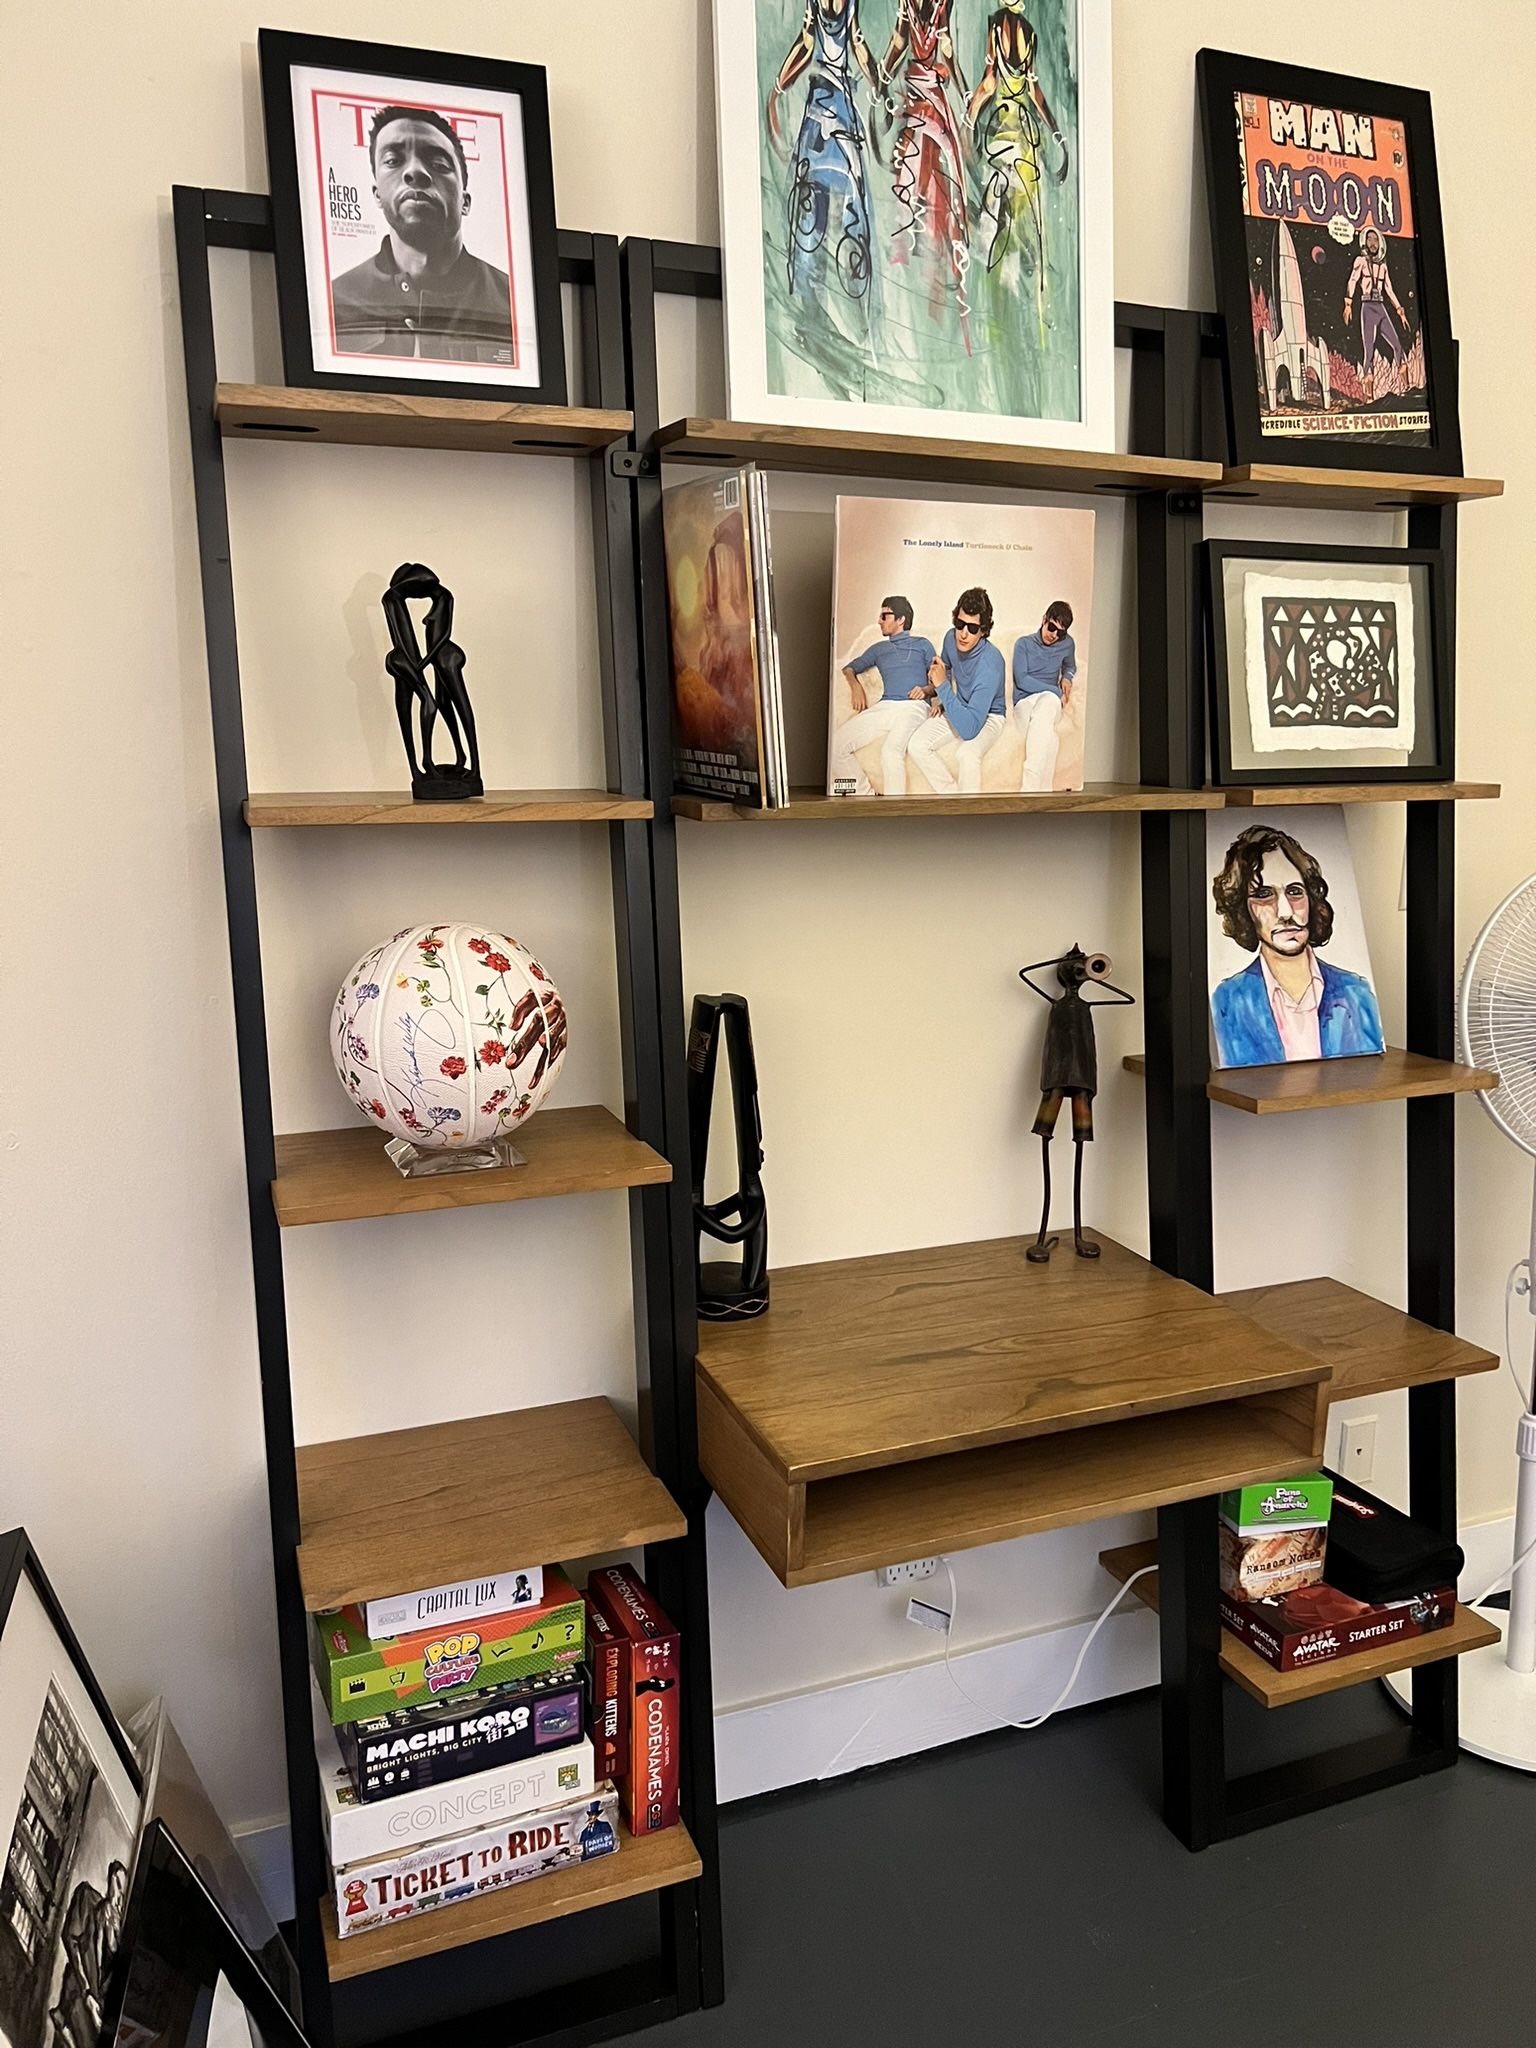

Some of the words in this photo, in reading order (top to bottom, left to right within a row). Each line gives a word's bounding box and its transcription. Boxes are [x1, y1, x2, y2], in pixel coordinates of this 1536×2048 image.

[339, 102, 480, 161] TE
[1267, 98, 1376, 159] MAN
[328, 166, 336, 184] A
[1306, 154, 1325, 165] ON
[1328, 156, 1349, 169] THE
[328, 184, 358, 204] HERO
[1261, 163, 1398, 228] MOON
[330, 201, 362, 221] RISES
[918, 539, 942, 548] Lonely
[1260, 1496, 1308, 1514] Anarchy
[1275, 1487, 1301, 1499] Puns
[1246, 1558, 1287, 1575] Ransom
[1289, 1549, 1321, 1565] Notes
[417, 1588, 471, 1620] CAPITAL
[474, 1581, 497, 1607] LUX
[606, 1569, 649, 1621] CODENAMES
[1348, 1624, 1387, 1643] STARTER
[1388, 1619, 1405, 1632] SET
[426, 1635, 478, 1665] POP
[1292, 1636, 1341, 1657] AVATAR
[425, 1656, 480, 1677] CULTURE
[429, 1665, 475, 1693] PARTY
[606, 1647, 619, 1697] EXPLODING
[604, 1698, 618, 1738] KITTENS
[366, 1725, 454, 1763] MACHI
[460, 1706, 531, 1734] KORO
[647, 1698, 662, 1801] CODENAMES
[366, 1757, 401, 1774] BRIGHT
[404, 1748, 441, 1763] LIGHTS,
[443, 1742, 459, 1753] BIG
[462, 1736, 482, 1748] CITY
[387, 1773, 546, 1837] CONCEPT
[371, 1851, 474, 1905] TICKET
[477, 1845, 503, 1869] TO
[507, 1822, 570, 1860] RIDE
